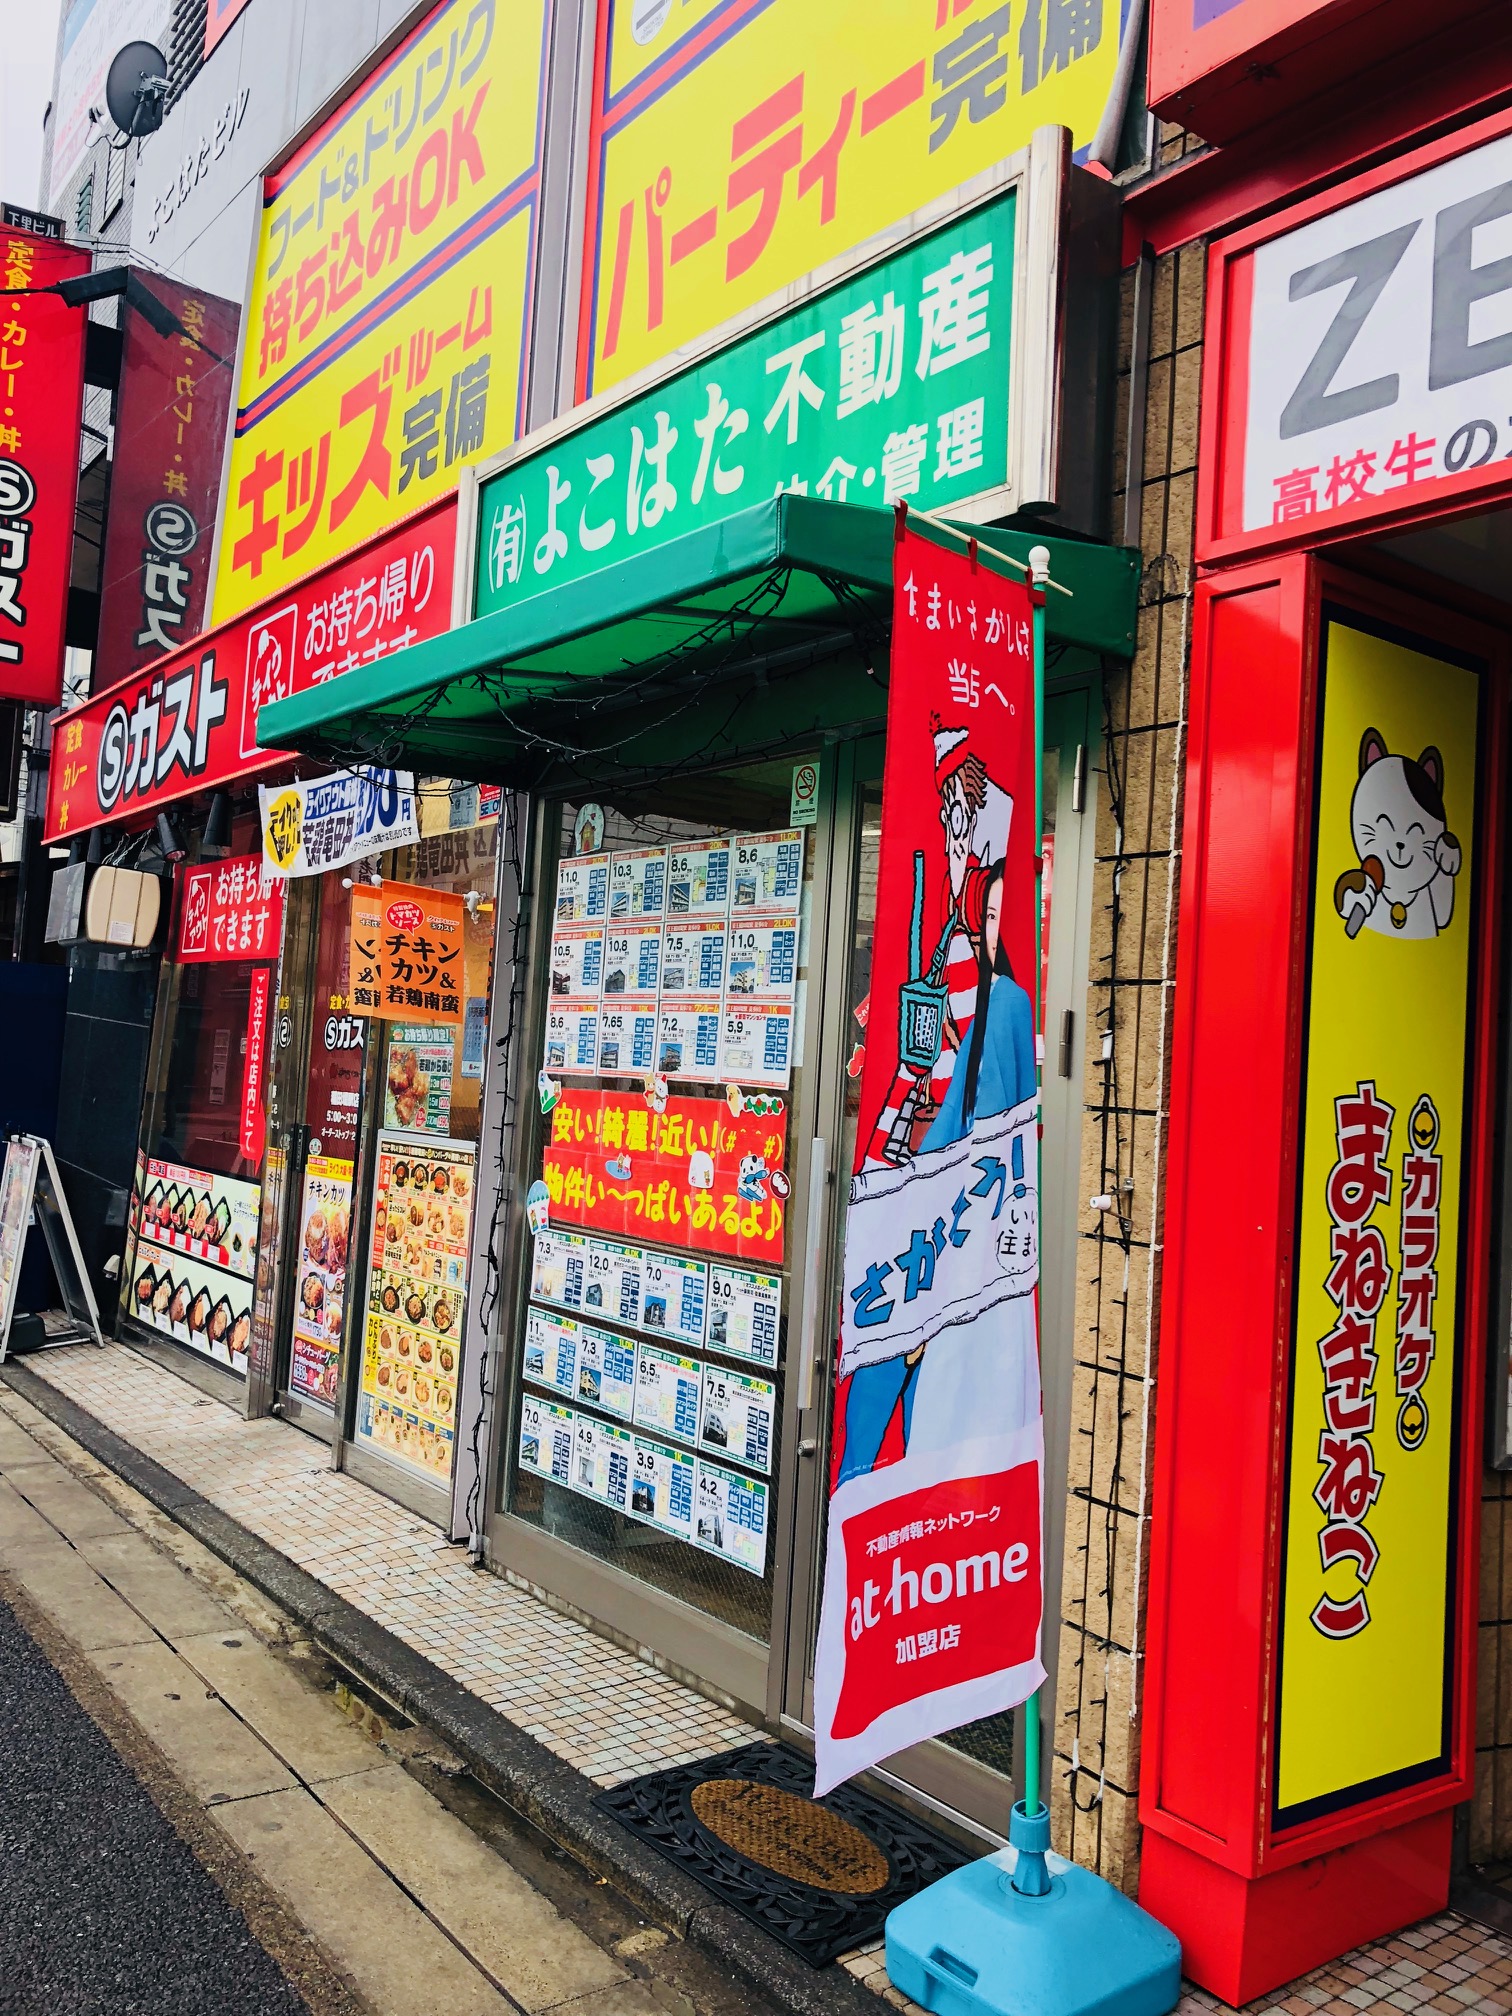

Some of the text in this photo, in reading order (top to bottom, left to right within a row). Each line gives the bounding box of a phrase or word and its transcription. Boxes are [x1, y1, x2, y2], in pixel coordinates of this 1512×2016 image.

[602, 58, 927, 361] パーティー
[8, 210, 58, 238] 下里ビル
[259, 79, 491, 380] 持ち込みOK
[398, 353, 491, 495] 完備
[1272, 420, 1512, 524] 高校生の
[304, 545, 435, 659] お持ち帰り
[66, 720, 84, 753] 定食
[63, 761, 87, 790] カレー
[671, 858, 688, 874] 8,6
[739, 848, 758, 864] 8,6
[560, 871, 578, 884] 11,0
[613, 864, 632, 878] 10,3
[214, 906, 270, 951] できます
[774, 919, 792, 928] 2LDK
[385, 934, 460, 964] チキン
[609, 939, 628, 953] 10,8
[666, 937, 683, 950] 7,5
[731, 933, 755, 949] 11,0
[391, 958, 457, 990] カツ&
[386, 984, 459, 1014] 若鶏南蛮
[769, 1006, 778, 1014] 1K
[602, 1016, 623, 1028] 7,65
[661, 1018, 678, 1032] 7,2
[727, 1021, 744, 1034] 5,9
[309, 1181, 345, 1206] チキンカツ
[1396, 1153, 1441, 1391] カラオケ
[640, 1361, 656, 1376] 6,5
[1311, 1080, 1395, 1640] まねきねこ
[636, 1452, 654, 1470] 3,9
[700, 1477, 717, 1496] 4,2
[745, 1480, 755, 1492] 1K
[866, 1505, 1001, 1558] 不動産情報ネットワーク
[884, 1542, 1029, 1616] home
[895, 1624, 961, 1665] 加盟店
